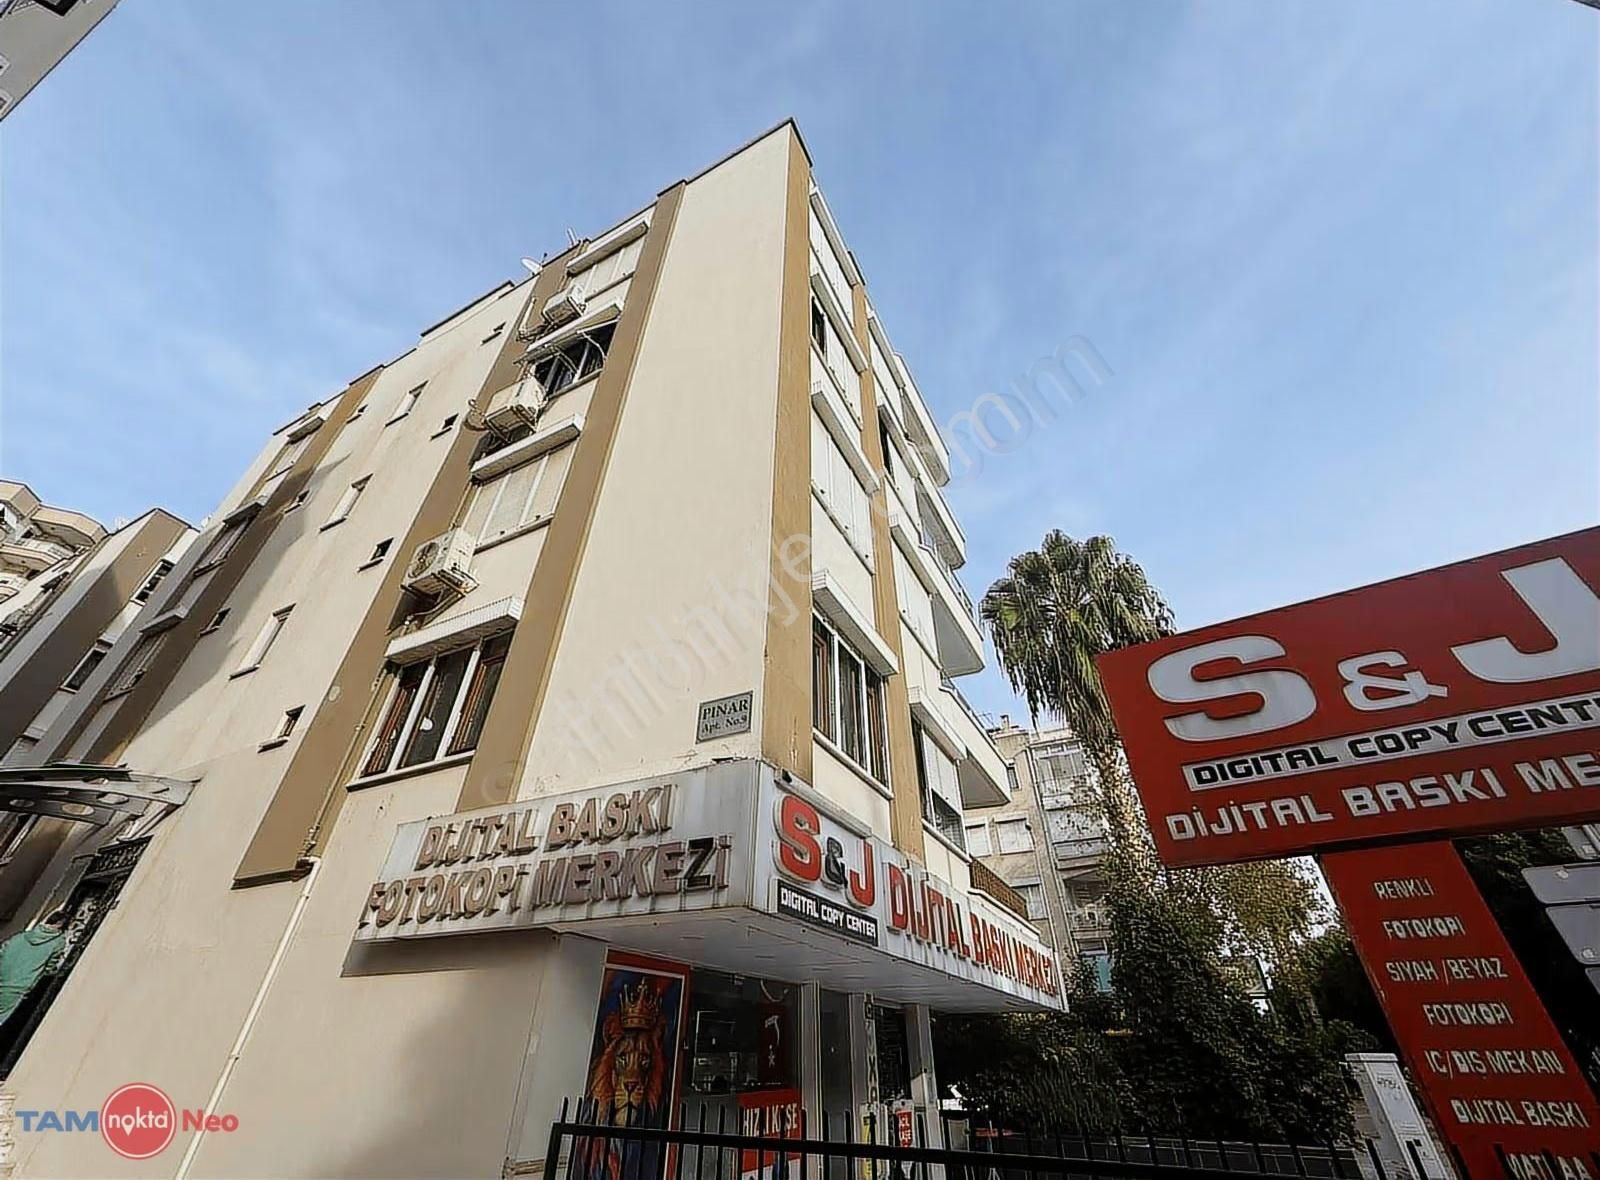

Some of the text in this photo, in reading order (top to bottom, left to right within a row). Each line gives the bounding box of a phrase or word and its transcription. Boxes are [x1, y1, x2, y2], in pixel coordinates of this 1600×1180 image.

[702, 699, 748, 720] PINAR
[1192, 697, 1600, 786] DIGITAL COPY CENT
[543, 784, 675, 853] BASKI
[1166, 750, 1600, 841] DİJİTAL BASKI ME
[358, 834, 732, 929] FOTOKOPİ MERKEZİ
[780, 887, 877, 938] DIGITAL COPY CENTER
[968, 910, 1016, 979] BASKI
[1521, 1101, 1591, 1129] BASKI
